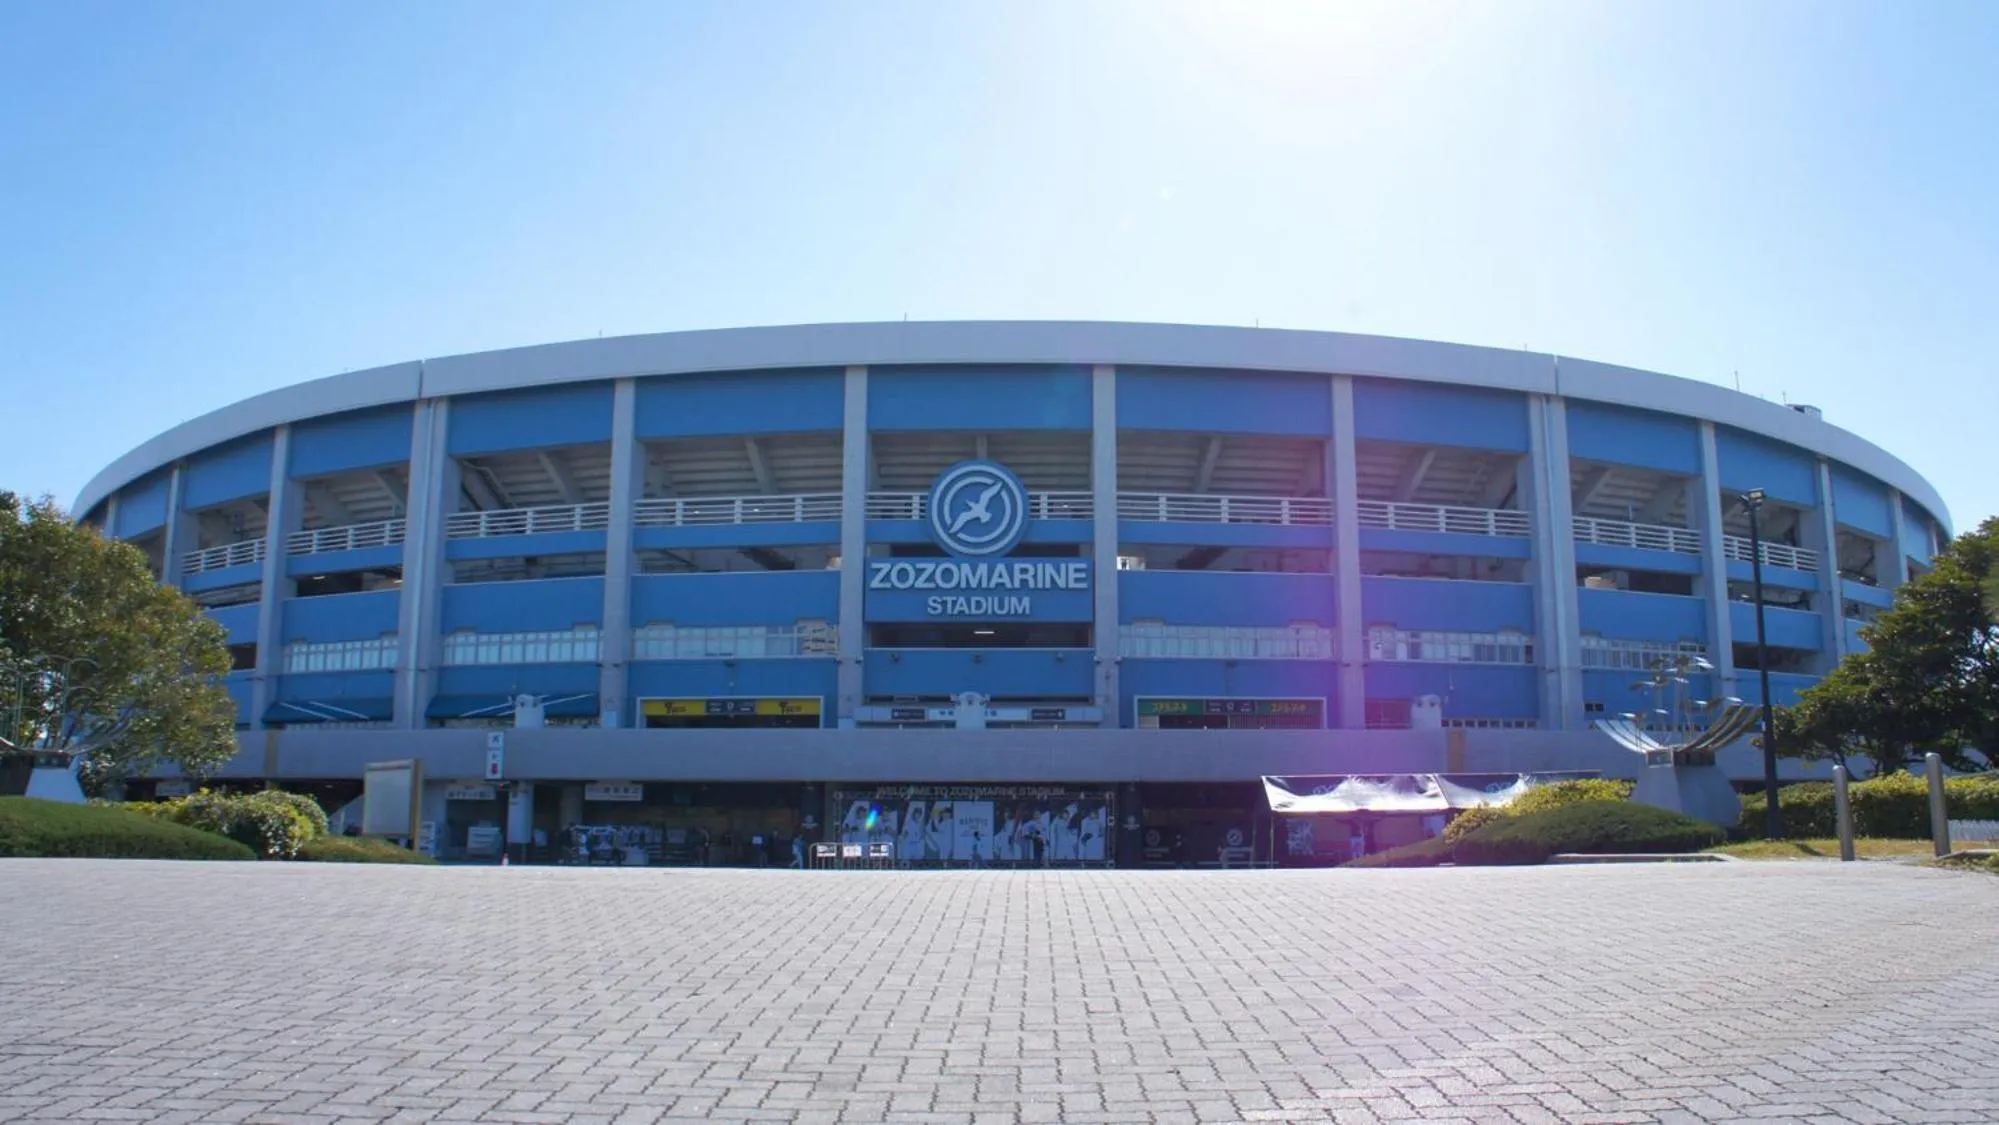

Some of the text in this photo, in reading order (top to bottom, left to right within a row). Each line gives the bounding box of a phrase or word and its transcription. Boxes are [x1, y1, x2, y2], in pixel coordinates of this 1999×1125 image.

[869, 563, 1088, 589] ZOZOMARINE
[927, 597, 1030, 616] STADIUM
[933, 786, 948, 796] TO
[1018, 786, 1065, 796] STADIUM
